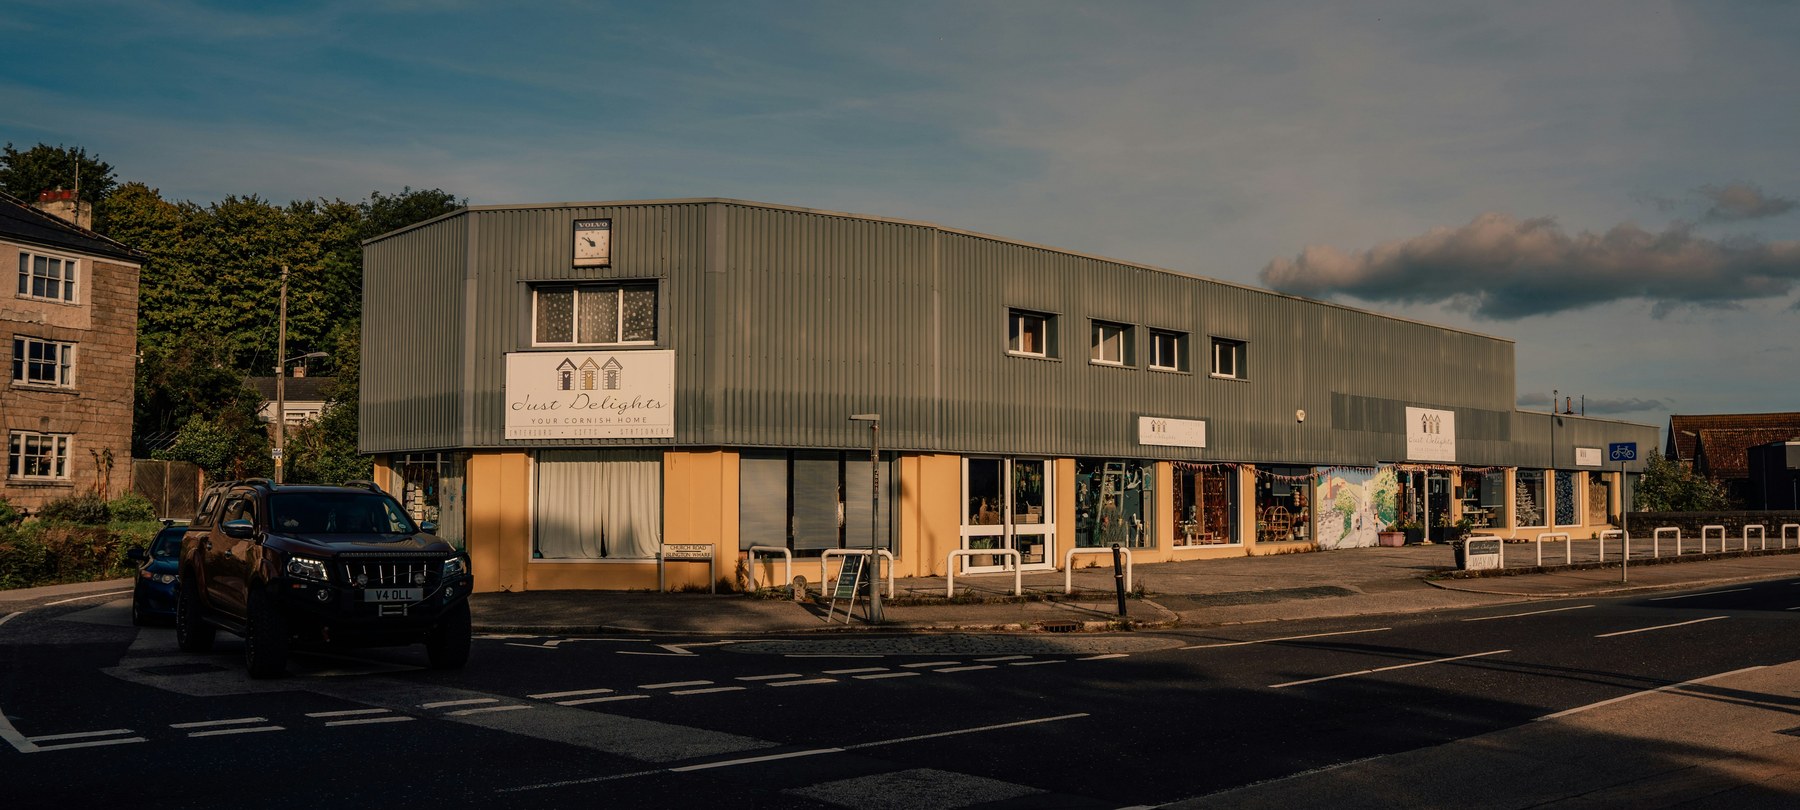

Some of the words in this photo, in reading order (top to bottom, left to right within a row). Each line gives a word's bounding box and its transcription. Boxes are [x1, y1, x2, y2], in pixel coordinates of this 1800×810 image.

[511, 394, 562, 411] Just
[568, 393, 667, 415] Delights
[617, 416, 647, 424] HOME
[376, 590, 389, 600] V4
